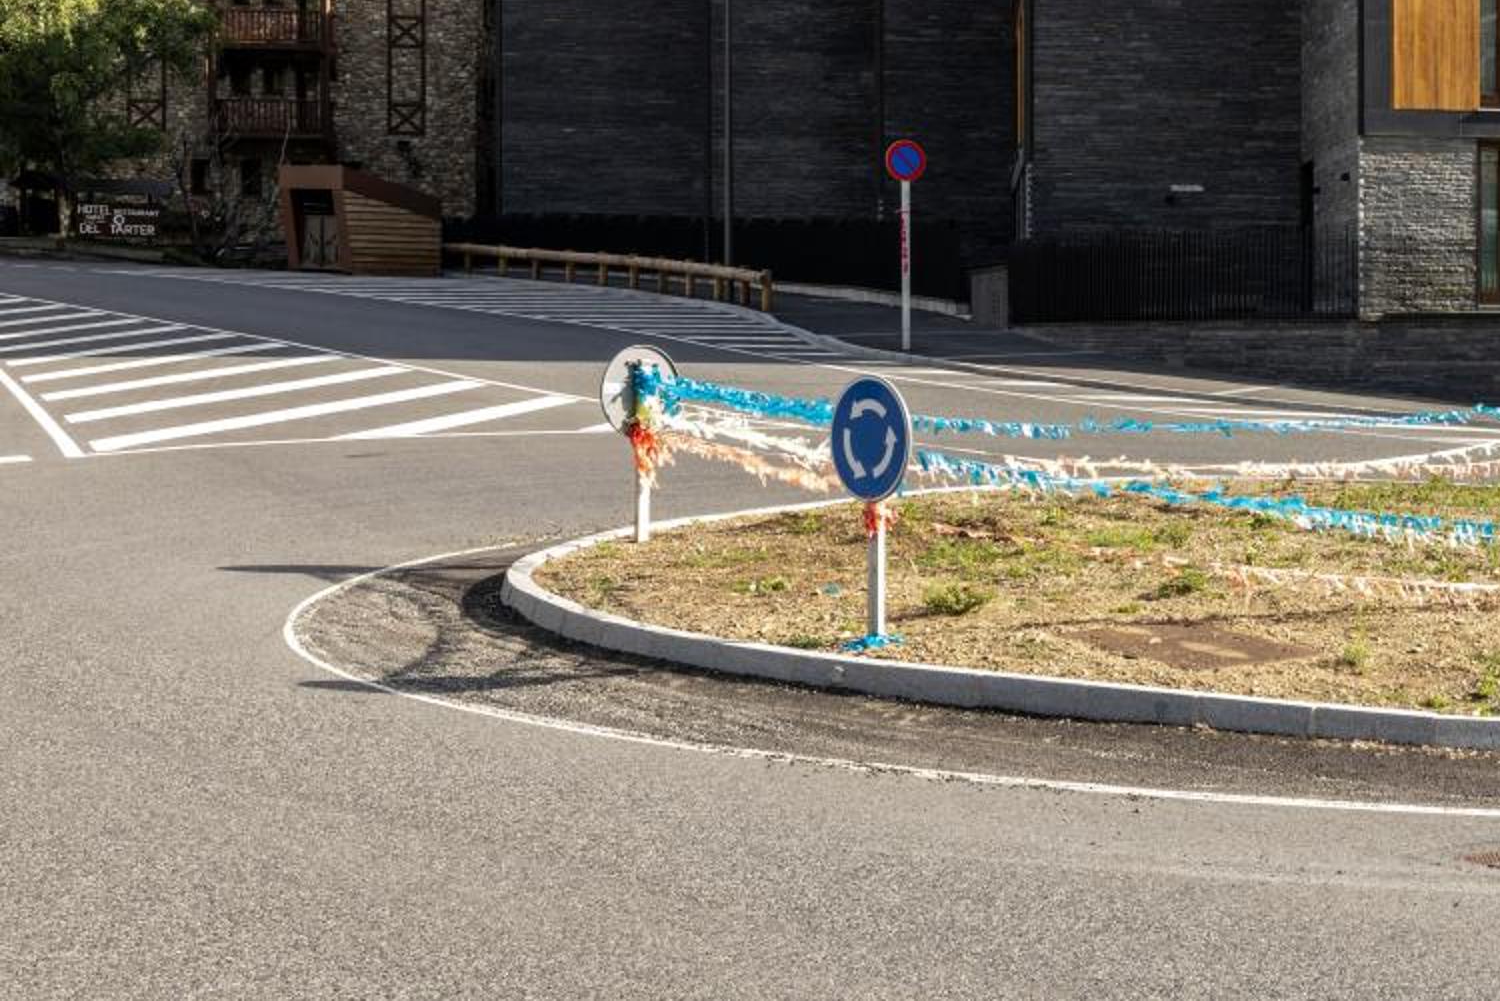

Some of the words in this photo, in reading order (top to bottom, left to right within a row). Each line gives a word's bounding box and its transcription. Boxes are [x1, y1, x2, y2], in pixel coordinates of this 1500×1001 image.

[77, 203, 112, 216] HOTEL
[79, 221, 101, 234] DEL
[111, 223, 156, 236] TARTER
